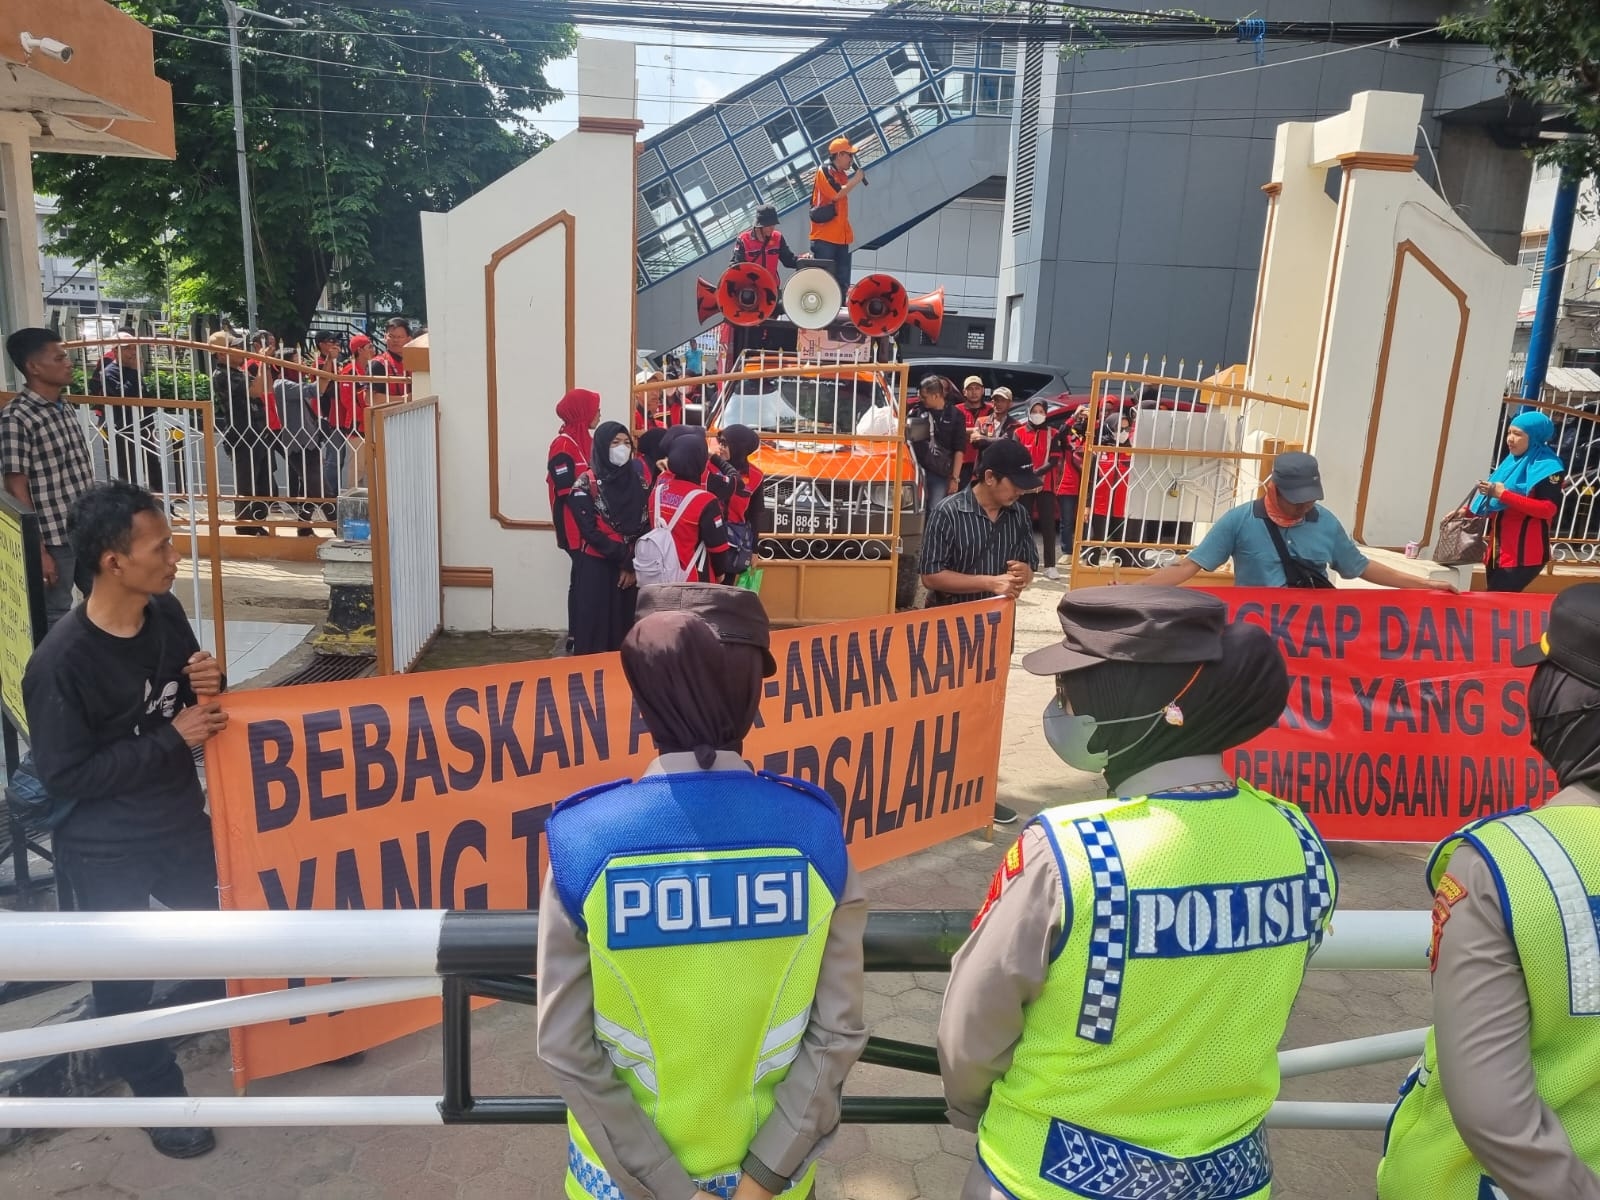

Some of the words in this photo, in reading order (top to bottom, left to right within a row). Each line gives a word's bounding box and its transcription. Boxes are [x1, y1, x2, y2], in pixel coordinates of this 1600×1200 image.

[775, 514, 789, 526] BG
[1379, 605, 1474, 662] DAN
[247, 669, 610, 833] BEBASKAN
[906, 611, 1002, 699] KAMI
[1350, 678, 1485, 736] YANG
[1234, 750, 1450, 817] PEMERKOSAAN
[1459, 756, 1515, 818] DAN
[613, 871, 803, 934] POLISI
[1134, 879, 1308, 954] POLISI
